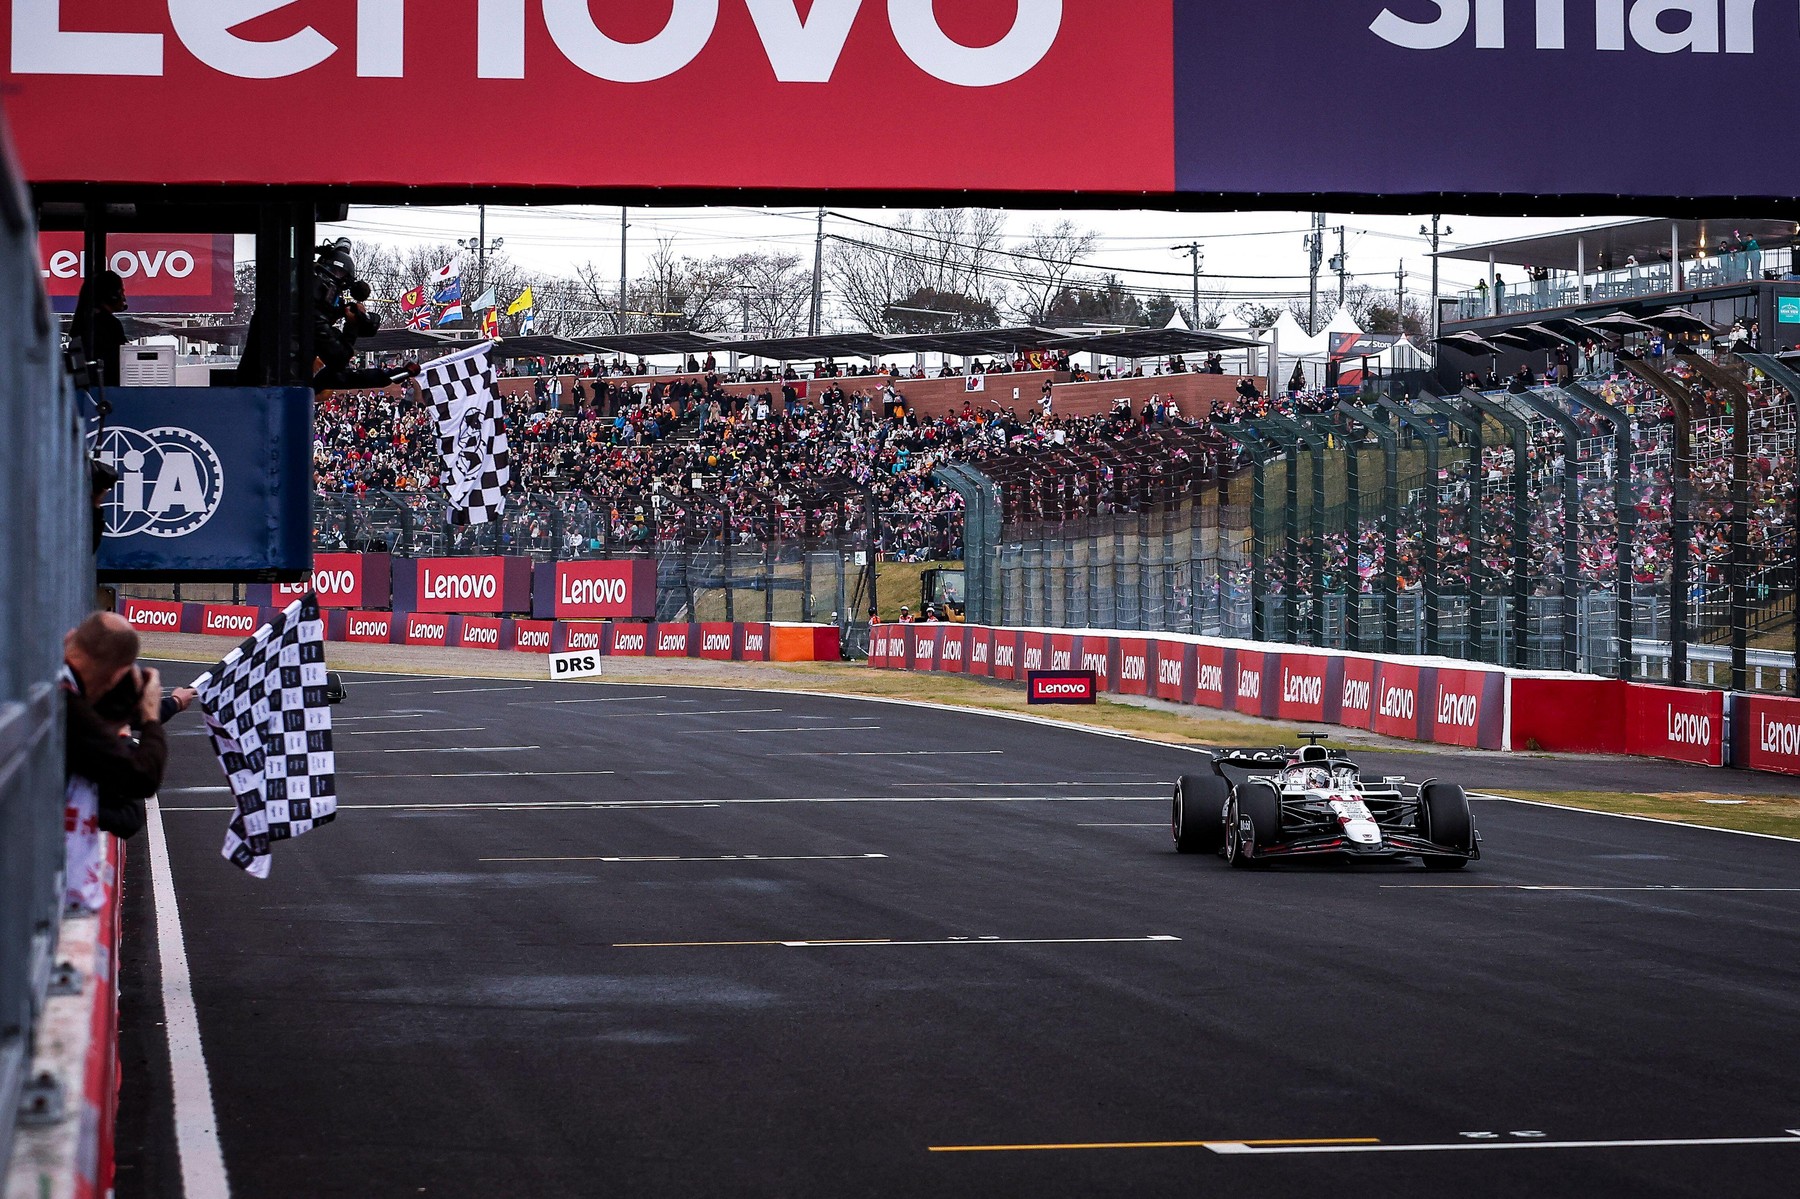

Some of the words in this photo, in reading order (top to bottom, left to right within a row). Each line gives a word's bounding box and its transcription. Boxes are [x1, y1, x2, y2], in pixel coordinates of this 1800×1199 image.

[40, 249, 195, 279] eovo
[424, 569, 497, 600] Lenovo
[561, 573, 627, 605] Lenovo
[128, 606, 177, 626] Lenovo
[207, 610, 253, 631] Lenovo
[349, 617, 388, 636] Lenovo
[409, 619, 444, 640] Lenovo
[463, 622, 497, 644] Lenovo
[517, 626, 550, 647] Lenovo
[568, 628, 599, 649] Lenovo
[614, 630, 644, 650] Lenovo
[658, 630, 686, 651] Lenovo
[702, 630, 730, 651] Lenovo
[744, 630, 763, 651] Lenovo
[555, 656, 595, 674] DRS
[1038, 682, 1086, 694] Lenovo
[1283, 666, 1322, 705] Lenovo
[1342, 670, 1370, 711] Lenovo
[1668, 702, 1710, 747] Lenovo
